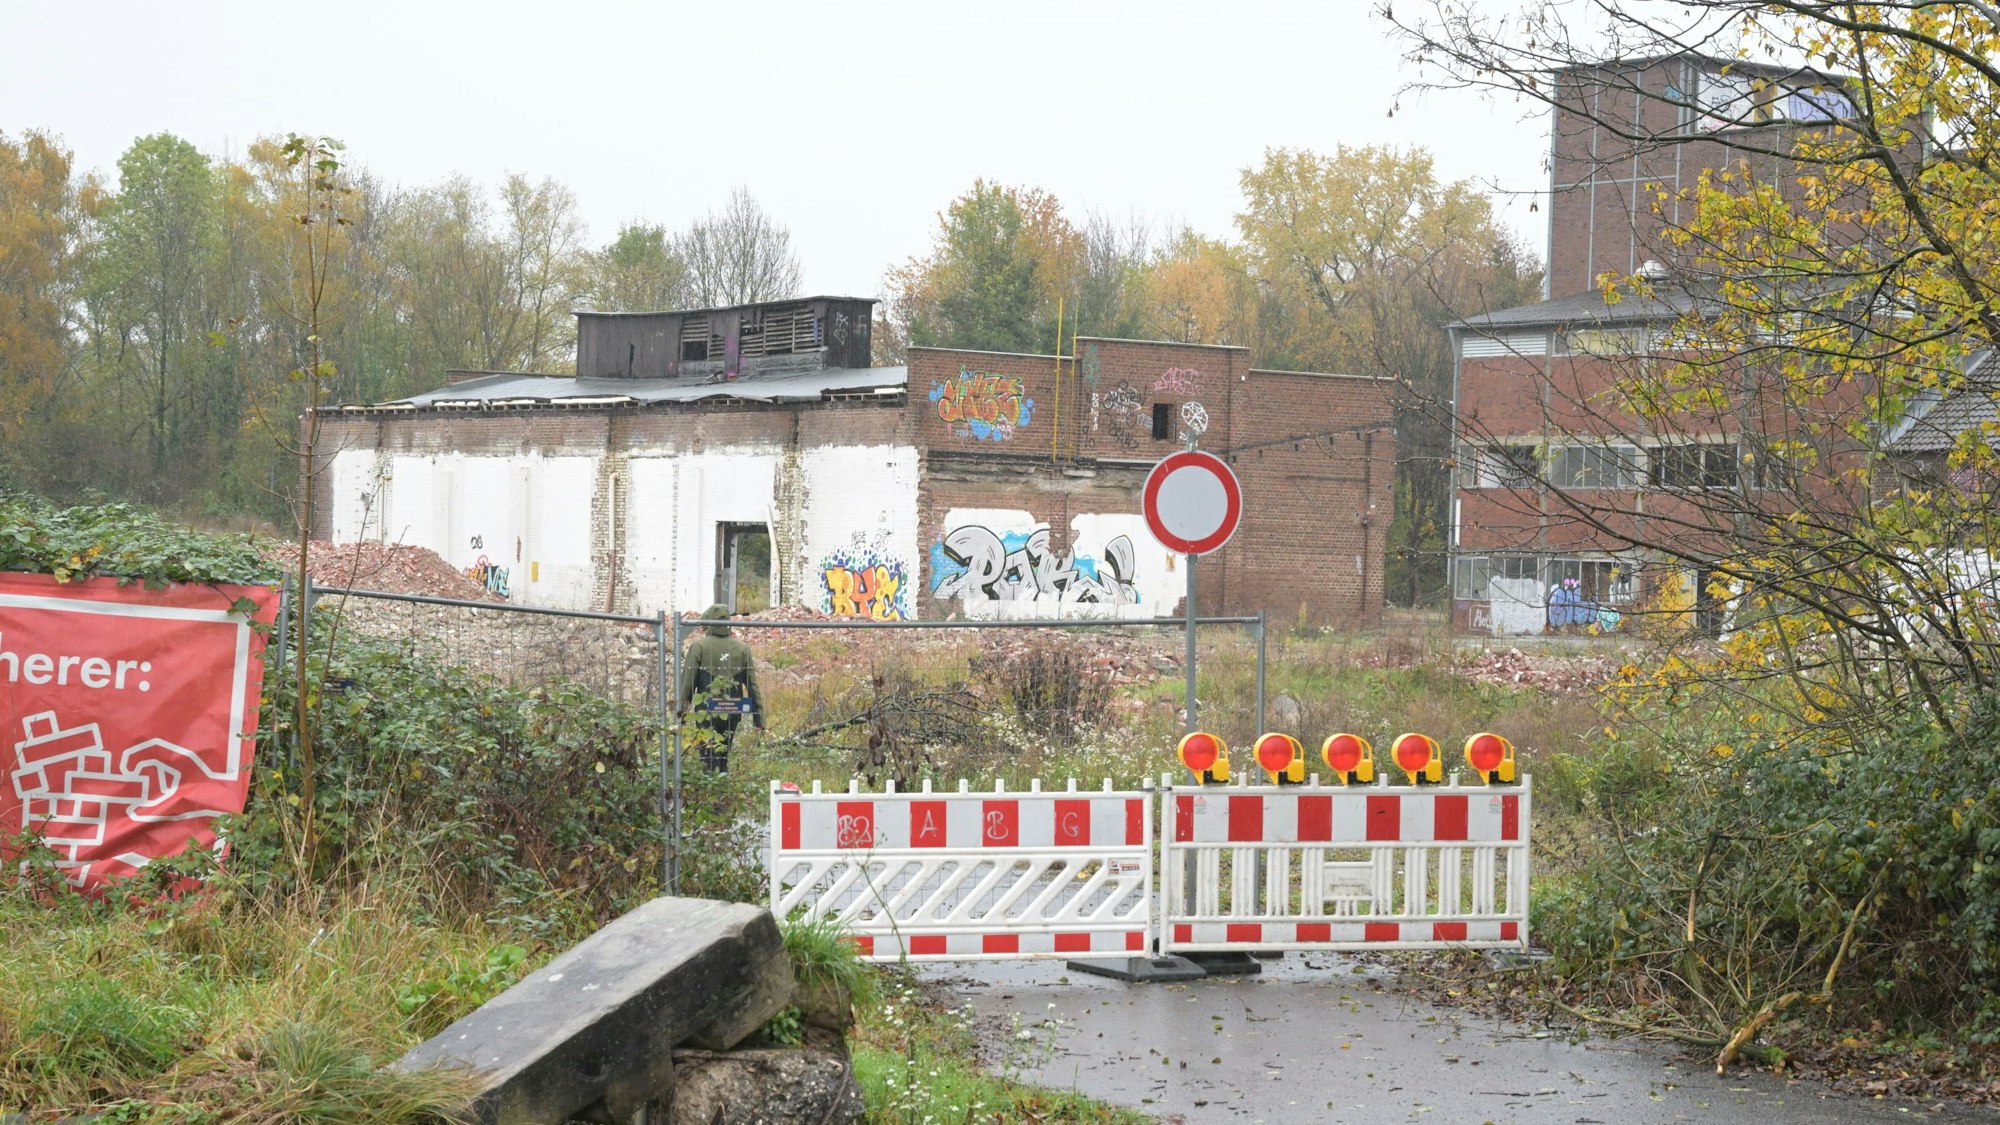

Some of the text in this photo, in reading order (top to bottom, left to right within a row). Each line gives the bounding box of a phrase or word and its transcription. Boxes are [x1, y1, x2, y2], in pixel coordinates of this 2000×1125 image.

[919, 809, 938, 840] A
[987, 810, 1010, 841] B
[1062, 811, 1080, 838] G
